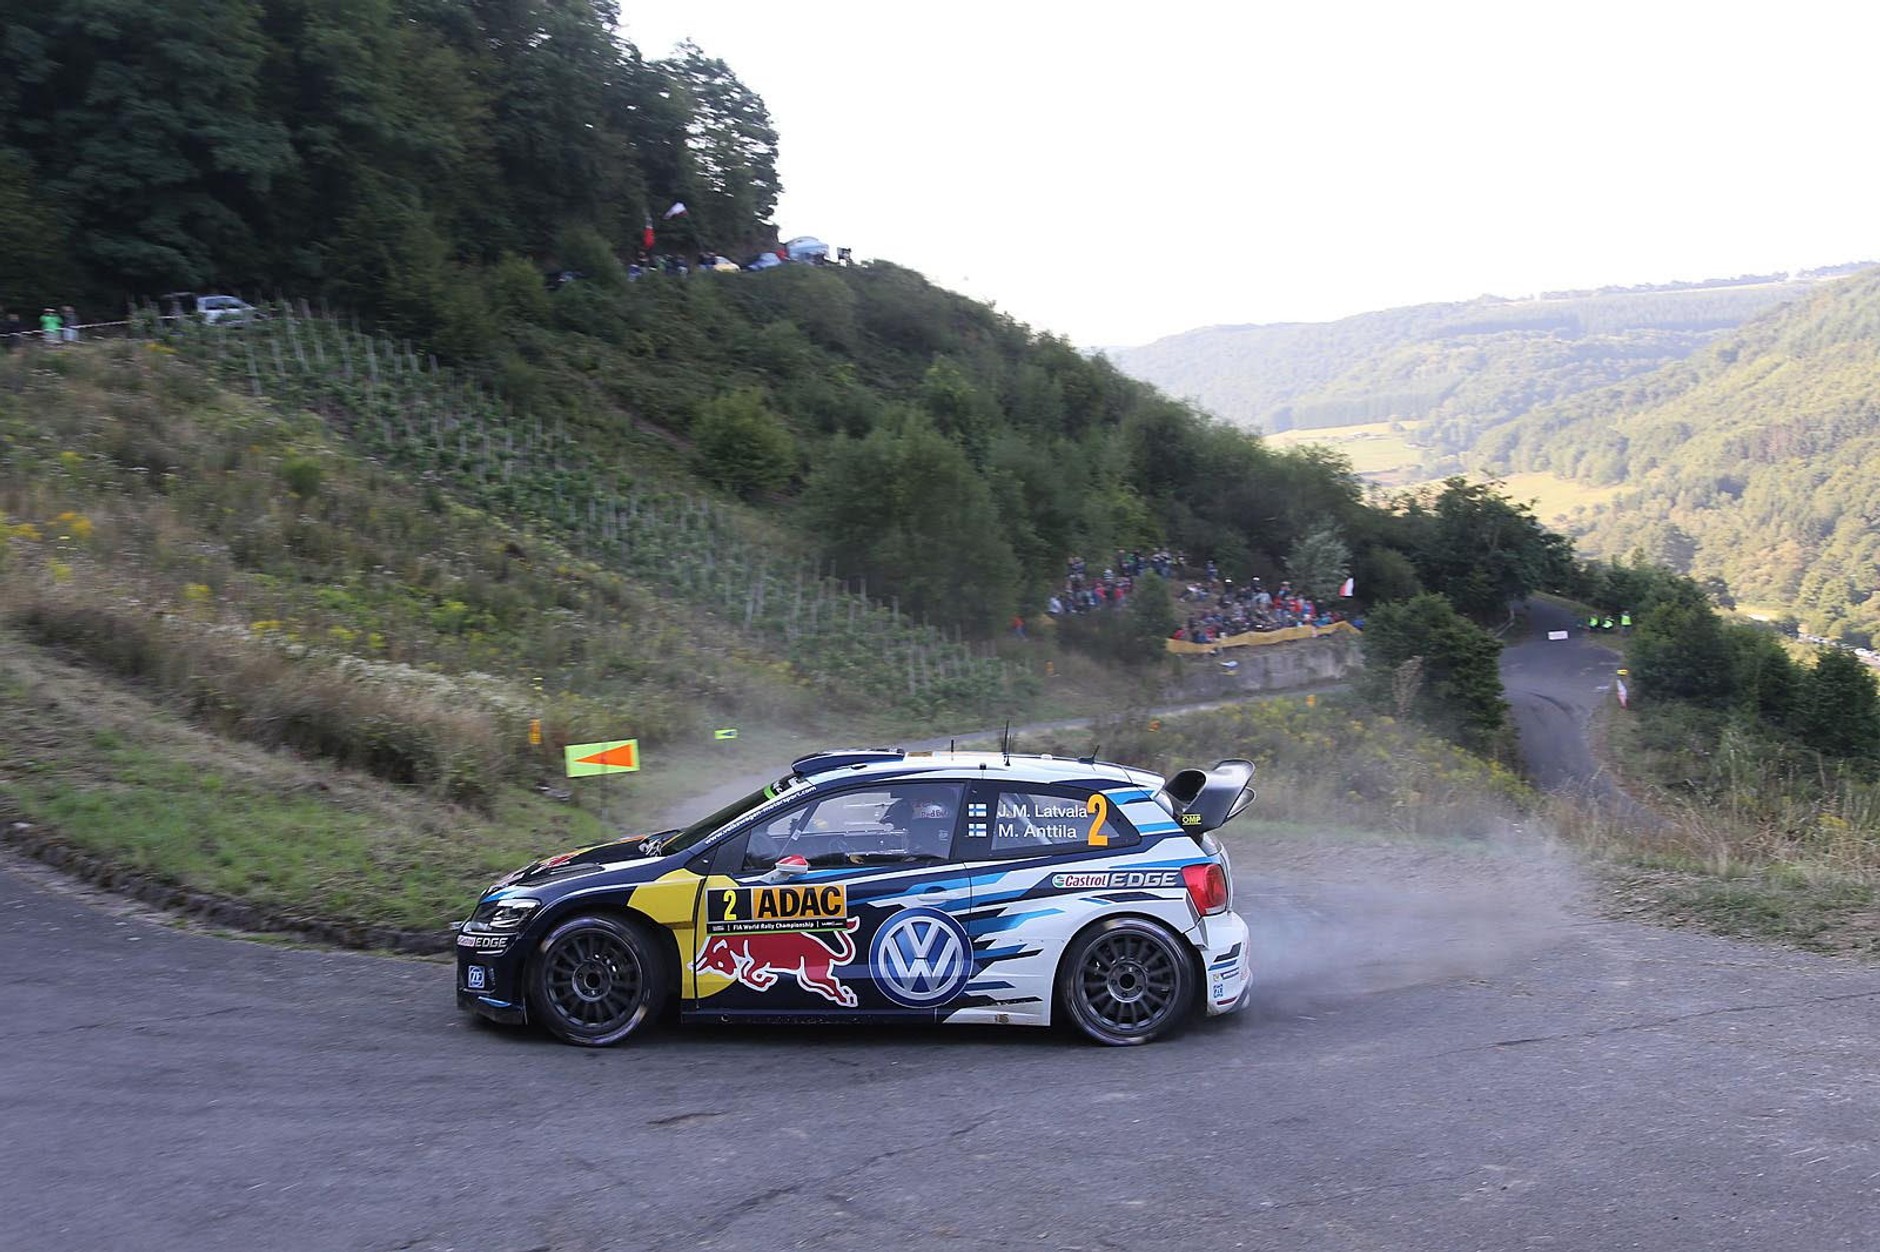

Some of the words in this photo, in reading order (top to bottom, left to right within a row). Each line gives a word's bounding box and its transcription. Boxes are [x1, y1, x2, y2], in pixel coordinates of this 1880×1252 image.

[998, 804, 1010, 818] J.
[1012, 804, 1031, 818] M.
[1035, 804, 1088, 818] Latvala
[1087, 793, 1109, 846] 2
[1182, 816, 1202, 824] OMP
[998, 824, 1019, 838] M.
[1023, 823, 1078, 838] Anttila
[1065, 875, 1107, 887] Castrol
[1108, 872, 1180, 887] EDGE
[723, 890, 738, 921] 2
[757, 886, 842, 918] ADAC
[743, 923, 760, 931] World
[760, 922, 776, 930] Rally
[775, 921, 815, 929] Championship
[475, 937, 508, 948] EDGE
